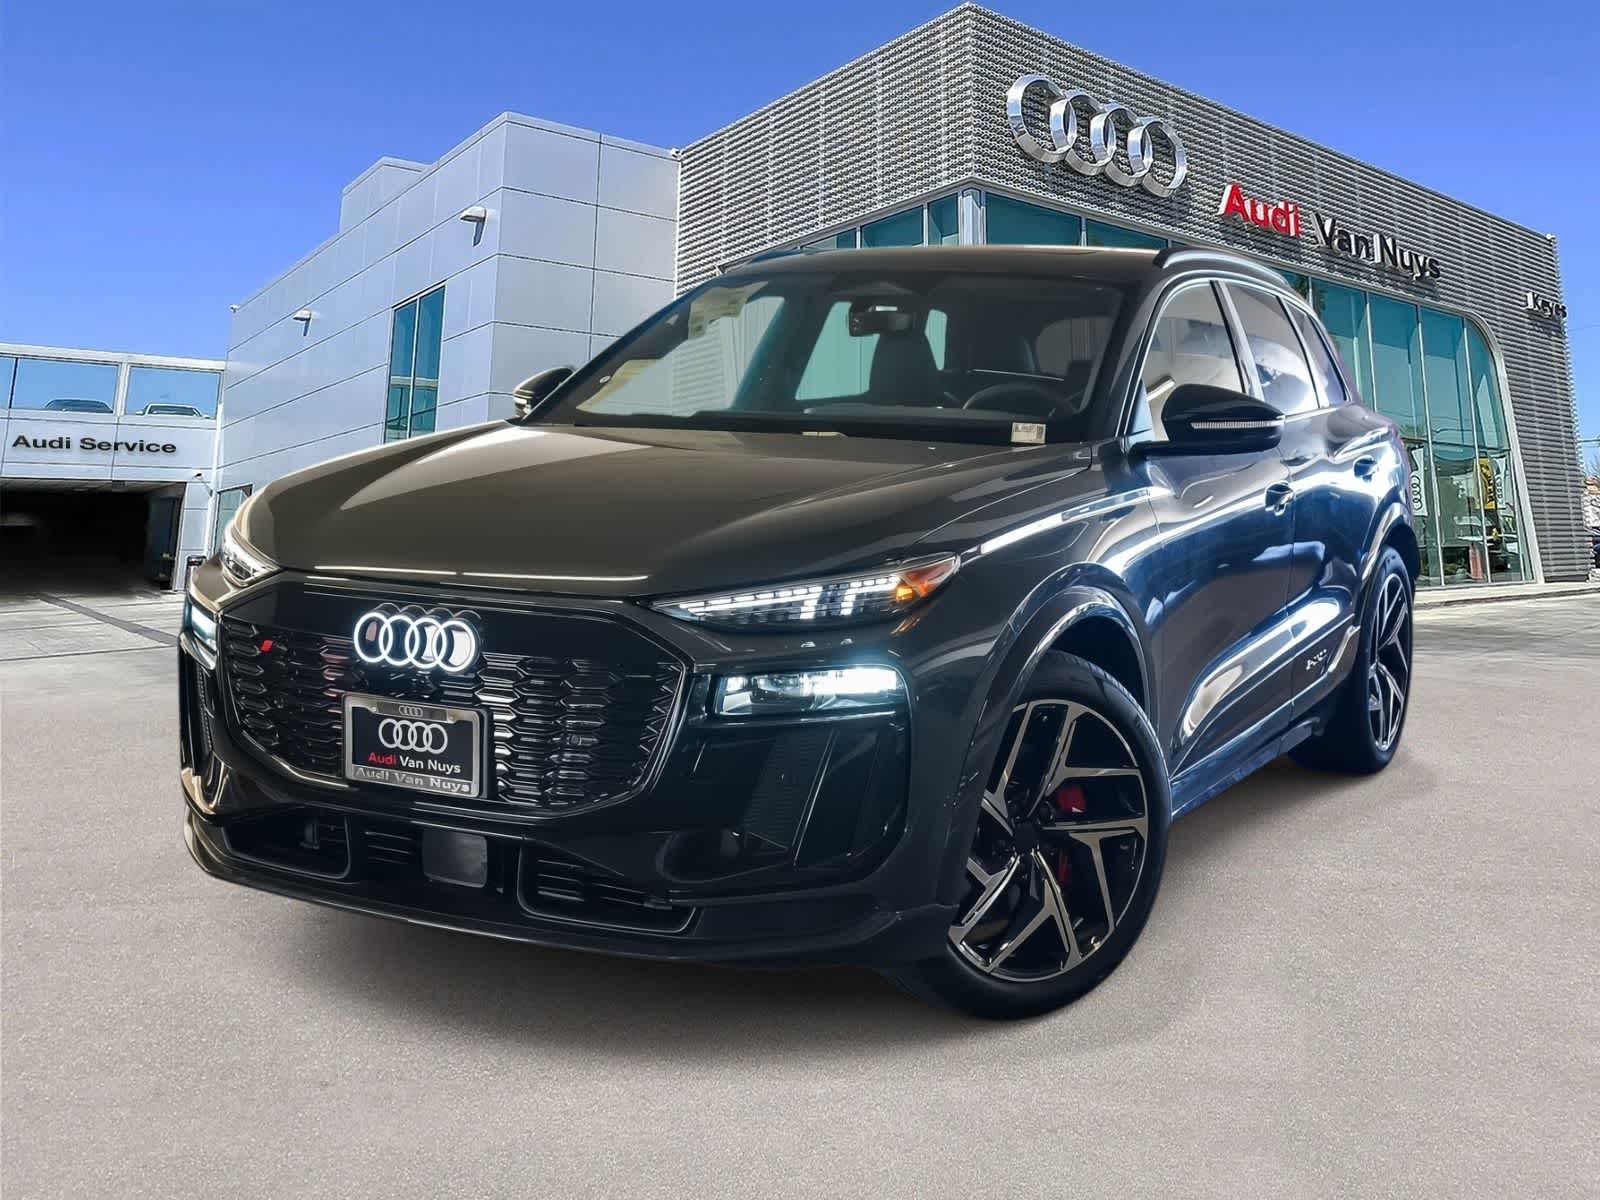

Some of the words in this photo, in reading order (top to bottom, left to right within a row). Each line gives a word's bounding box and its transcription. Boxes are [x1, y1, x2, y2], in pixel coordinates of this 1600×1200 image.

[1218, 183, 1301, 237] Audi
[1312, 211, 1370, 259] Van
[1374, 232, 1441, 281] Nuys
[12, 435, 71, 449] Audi
[79, 437, 177, 453] Service
[368, 752, 397, 766] Audi
[399, 755, 424, 769] Van
[427, 759, 461, 775] Nuys
[355, 767, 389, 780] Audi
[394, 772, 424, 786] Van
[429, 777, 470, 793] Nuys
